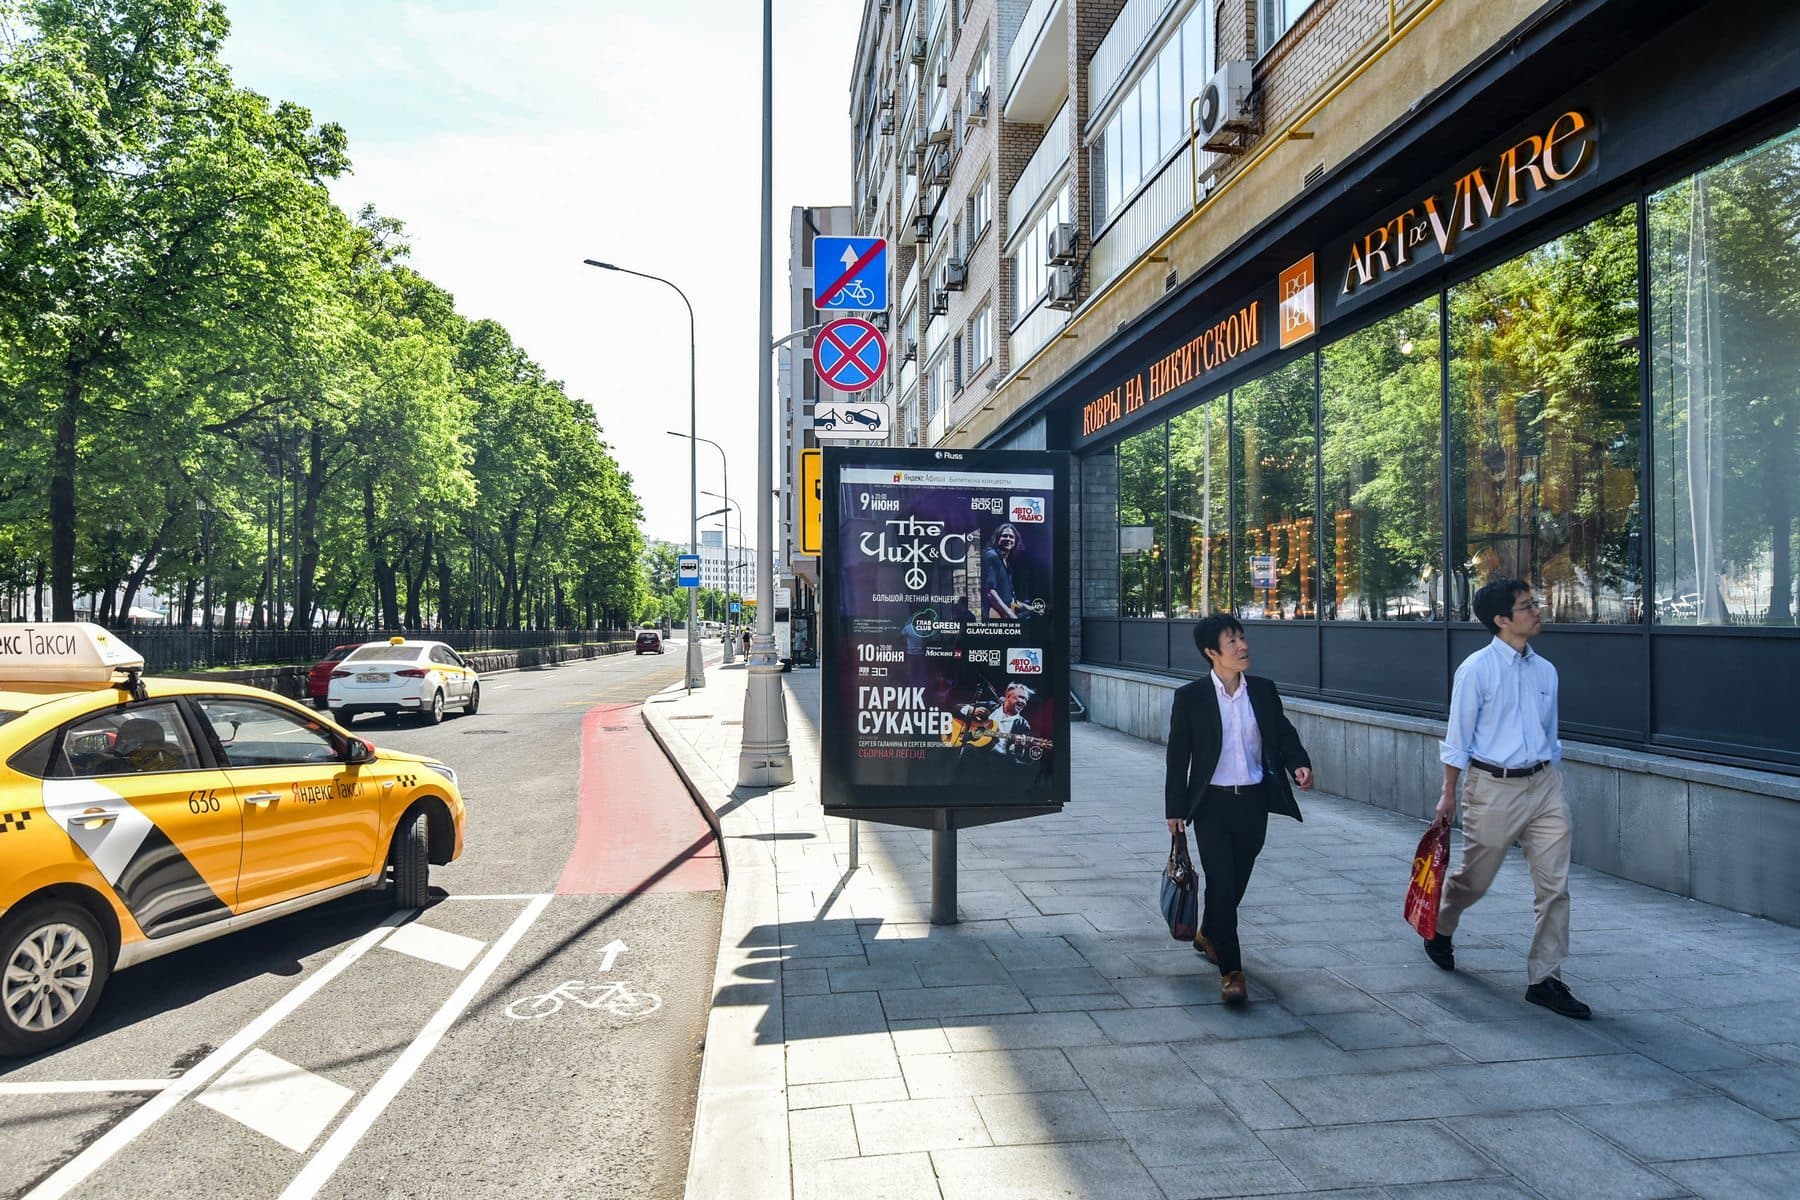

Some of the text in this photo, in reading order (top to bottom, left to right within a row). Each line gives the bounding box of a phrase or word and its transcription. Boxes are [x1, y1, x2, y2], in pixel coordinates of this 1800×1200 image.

[1342, 207, 1416, 296] ART
[1082, 387, 1121, 438] КОВРЫ
[1125, 379, 1146, 418] НА
[1148, 301, 1260, 402] НИКИТСКОМ
[943, 451, 963, 460] Russ
[860, 492, 870, 511] 9
[971, 502, 991, 511] BOX
[1017, 514, 1043, 522] РАДИО
[886, 515, 945, 537] The
[872, 593, 904, 602] БОЛЬШОЙ
[905, 594, 930, 602] ЛЕТНИЙ
[932, 622, 960, 630] GREEN
[966, 628, 1021, 636] GLAVCLUB.COM
[24, 628, 77, 656] Такси
[857, 643, 875, 662] 10
[968, 654, 989, 663] BOX
[1009, 658, 1030, 666] АВТО
[1015, 665, 1041, 673] РАДИО
[858, 686, 926, 710] ГАРИК
[857, 706, 953, 735] СУКАЧЁВ
[858, 749, 925, 760] СБОРНАЯ ЛЕГЕНД
[292, 778, 365, 804] Яндекс Такси
[188, 789, 220, 815] 636
